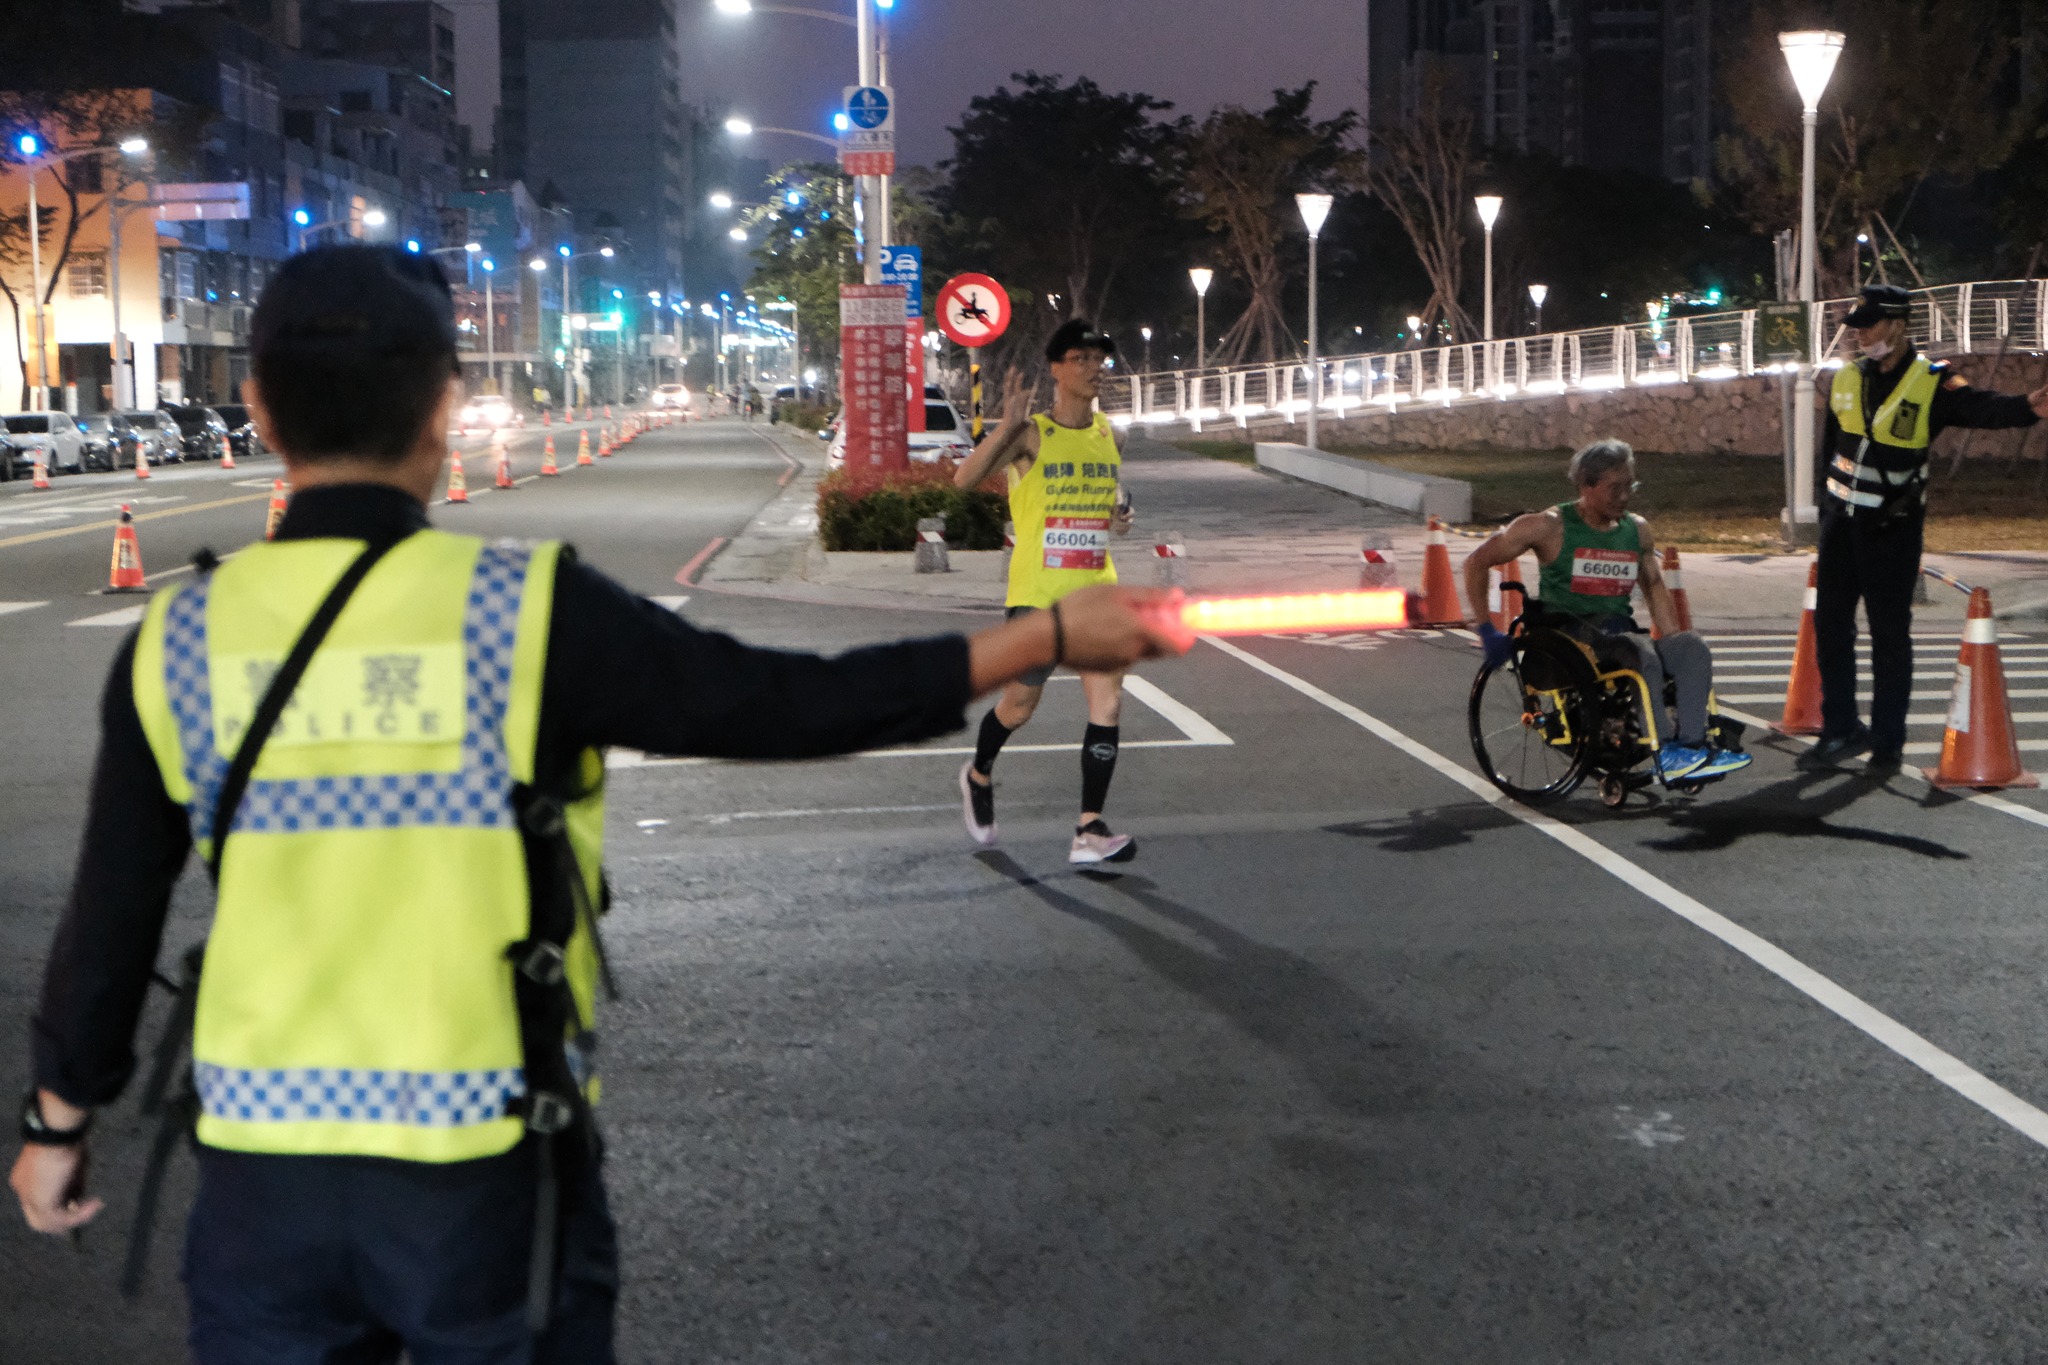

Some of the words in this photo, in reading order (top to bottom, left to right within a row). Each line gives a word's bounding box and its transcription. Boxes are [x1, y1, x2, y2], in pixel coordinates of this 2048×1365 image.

[1045, 484, 1080, 496] Guide
[1045, 532, 1097, 547] 66004
[1583, 563, 1629, 576] 66004
